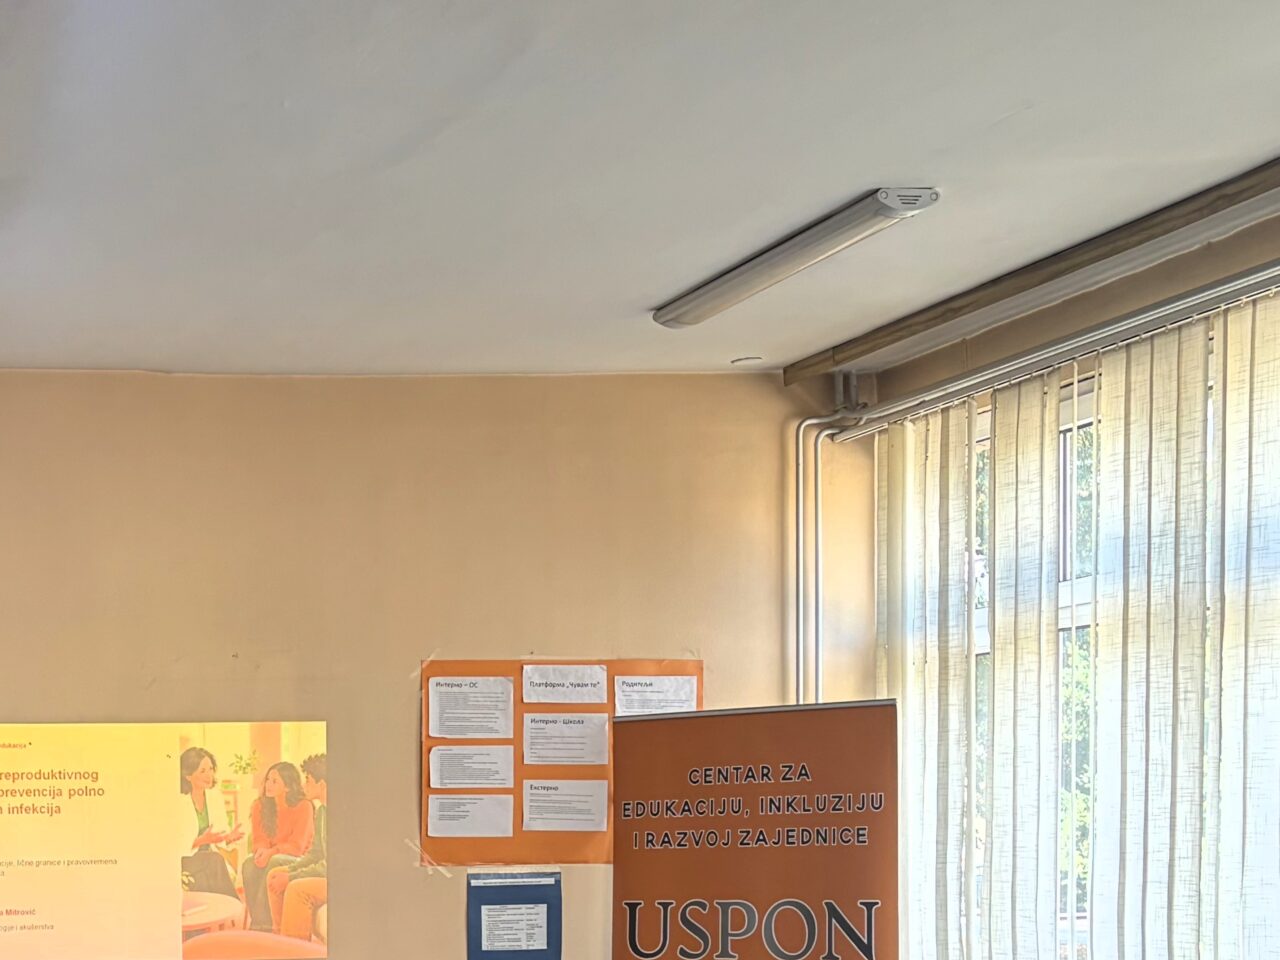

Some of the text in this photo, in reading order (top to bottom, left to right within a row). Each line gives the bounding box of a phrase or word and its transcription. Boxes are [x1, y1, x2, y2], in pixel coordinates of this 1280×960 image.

[435, 681, 463, 689] Интерно
[529, 680, 565, 689] Платформа
[530, 718, 558, 726] Интерно
[0, 768, 99, 783] reproduktivnog
[687, 762, 812, 786] CENTAR ZA
[68, 785, 105, 799] polno
[7, 802, 62, 817] infekcija
[621, 797, 750, 820] EDUKACIJU,
[759, 792, 885, 816] INKLUZIJU
[633, 826, 869, 850] I RAZVOJ ZAJEDNICE
[35, 859, 62, 868] granice
[66, 858, 118, 867] pravovremena
